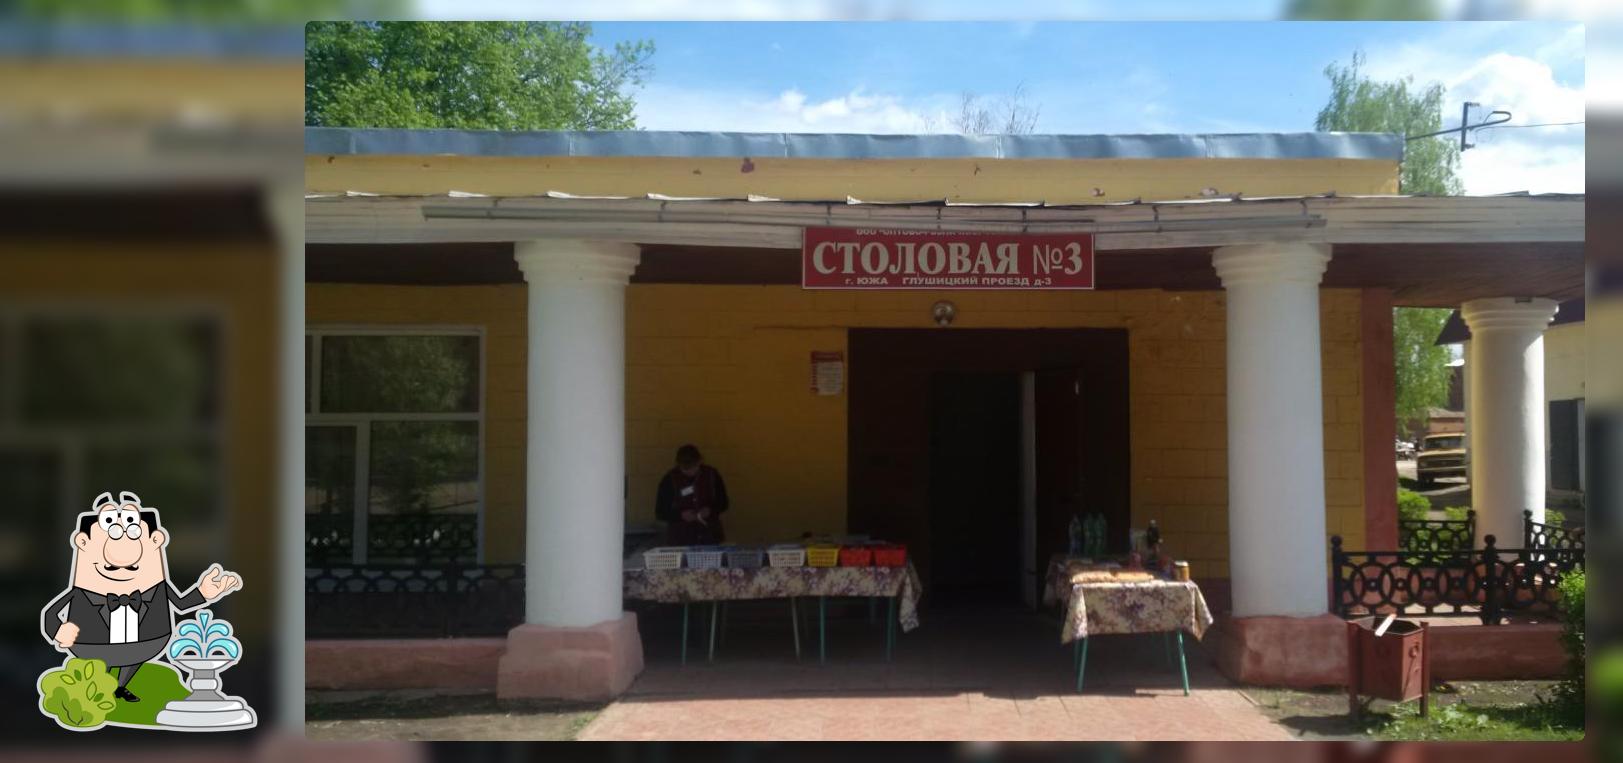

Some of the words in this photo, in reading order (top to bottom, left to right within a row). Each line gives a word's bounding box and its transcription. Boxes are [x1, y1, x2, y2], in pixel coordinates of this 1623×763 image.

[812, 241, 1020, 275] СТОЛОВАЯ
[857, 277, 888, 285] ЮЖА
[902, 277, 978, 286] ГЛУШИЦКИЙ
[981, 278, 1030, 286] ПРОЕЗД
